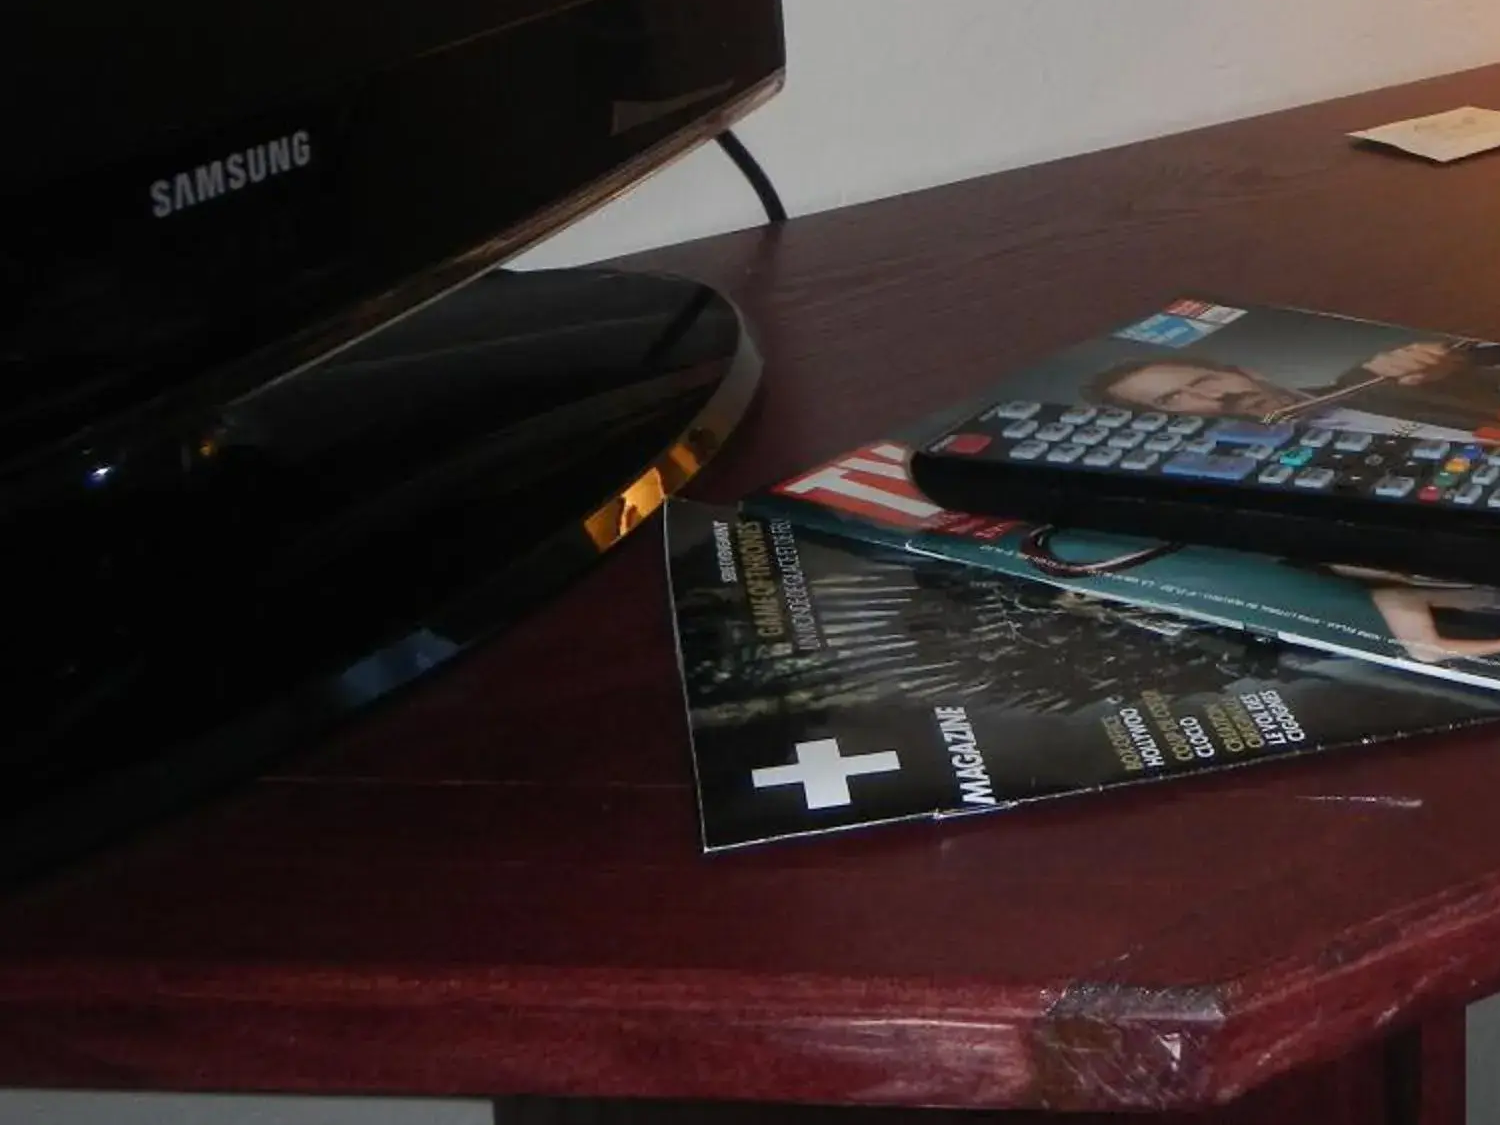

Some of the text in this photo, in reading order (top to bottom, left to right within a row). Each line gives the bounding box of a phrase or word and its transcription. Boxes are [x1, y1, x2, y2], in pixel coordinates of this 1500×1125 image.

[149, 130, 312, 218] SAMSUNG
[749, 595, 785, 638] GAME
[1119, 707, 1166, 767] HOLLYWOO
[1179, 715, 1216, 759] CLOCLO
[1239, 692, 1288, 746] LE VOL DES
[1258, 689, 1306, 742] CIGOGNES
[933, 705, 998, 806] MAGAZINE
